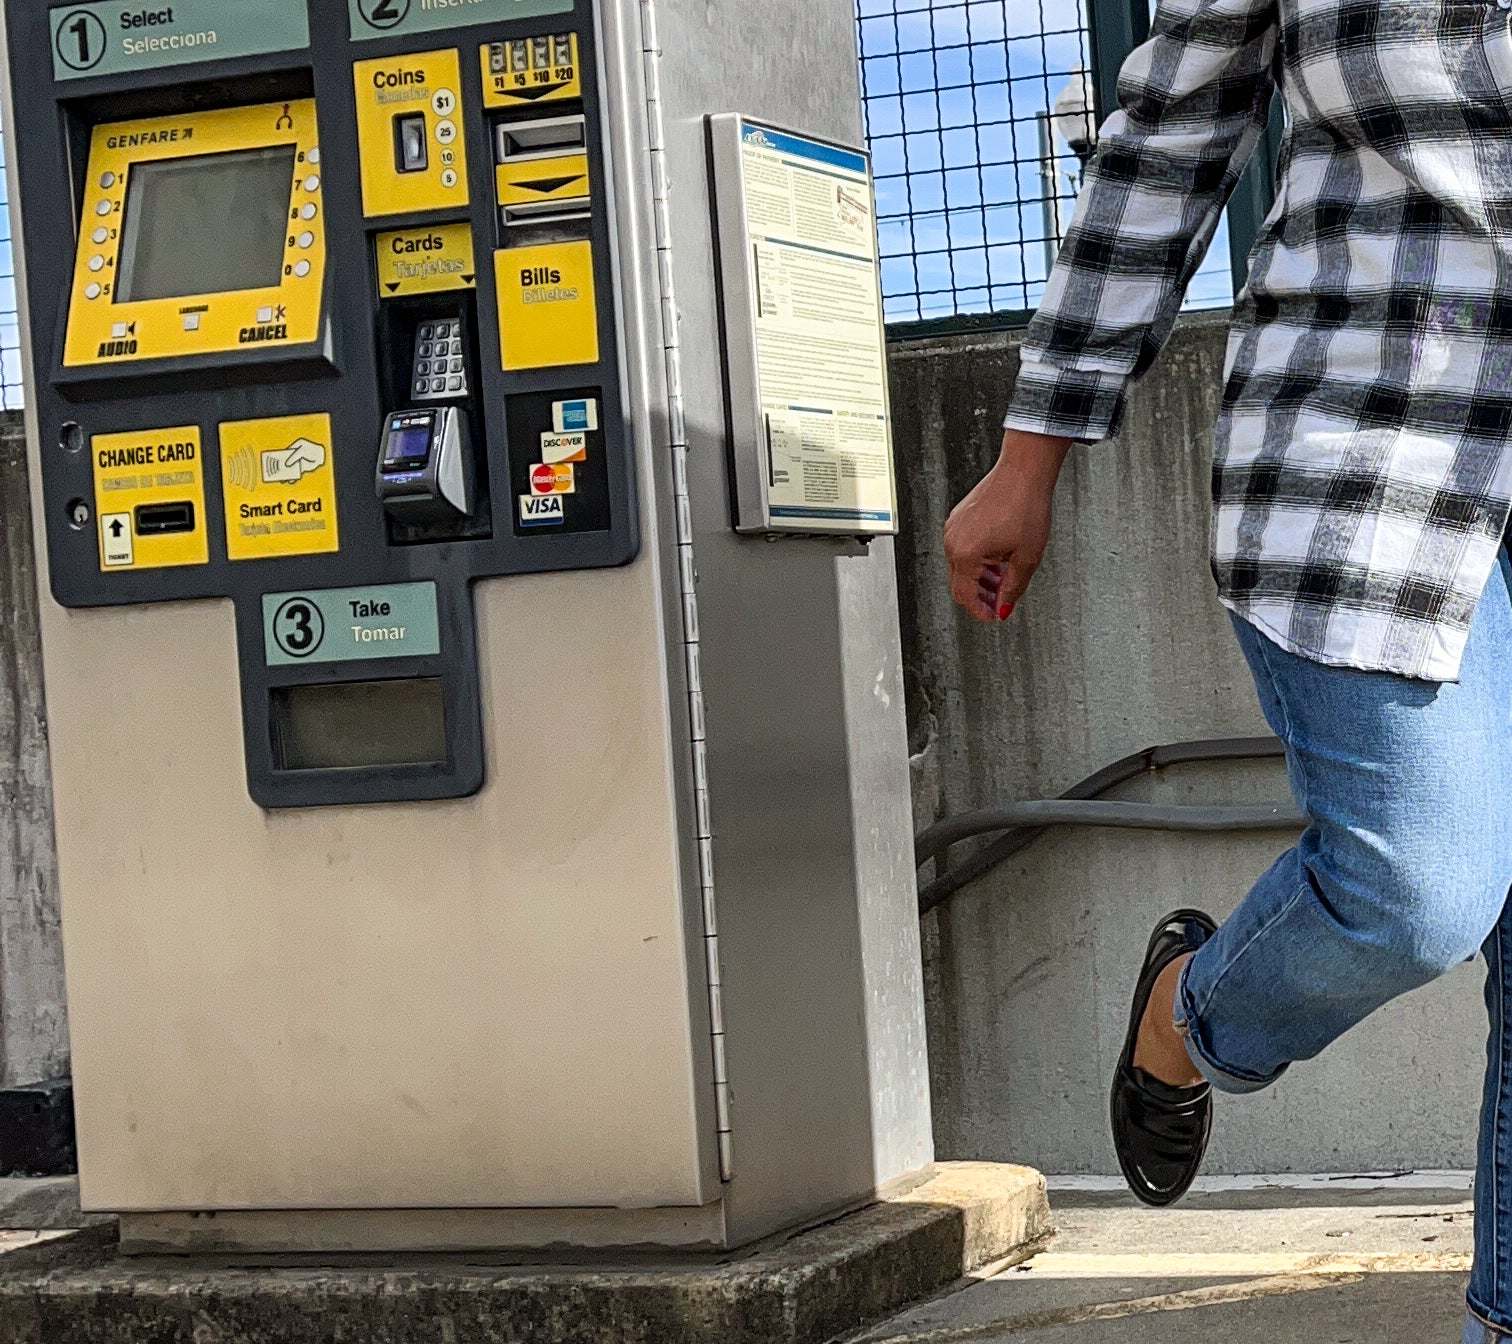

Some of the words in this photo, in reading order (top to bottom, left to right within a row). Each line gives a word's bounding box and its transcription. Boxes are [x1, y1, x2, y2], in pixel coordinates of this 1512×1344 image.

[120, 6, 174, 30] Select
[69, 17, 90, 63] 1
[122, 29, 217, 56] Selecciona
[373, 67, 426, 89] Coins
[555, 66, 574, 81] $20
[436, 95, 450, 109] $1
[107, 129, 178, 150] GENFARE
[440, 126, 452, 138] 25
[392, 234, 444, 255] Cards
[520, 266, 562, 287] Bills
[239, 323, 288, 343] CANCEL
[97, 339, 138, 358] AUDIO
[99, 445, 154, 469] CHANGE
[157, 442, 195, 463] CARD
[240, 501, 283, 519] Smart
[287, 497, 323, 514] Card
[524, 496, 562, 515] VISA
[349, 599, 391, 618] Take
[285, 604, 313, 650] 3
[351, 625, 406, 643] Tomar
